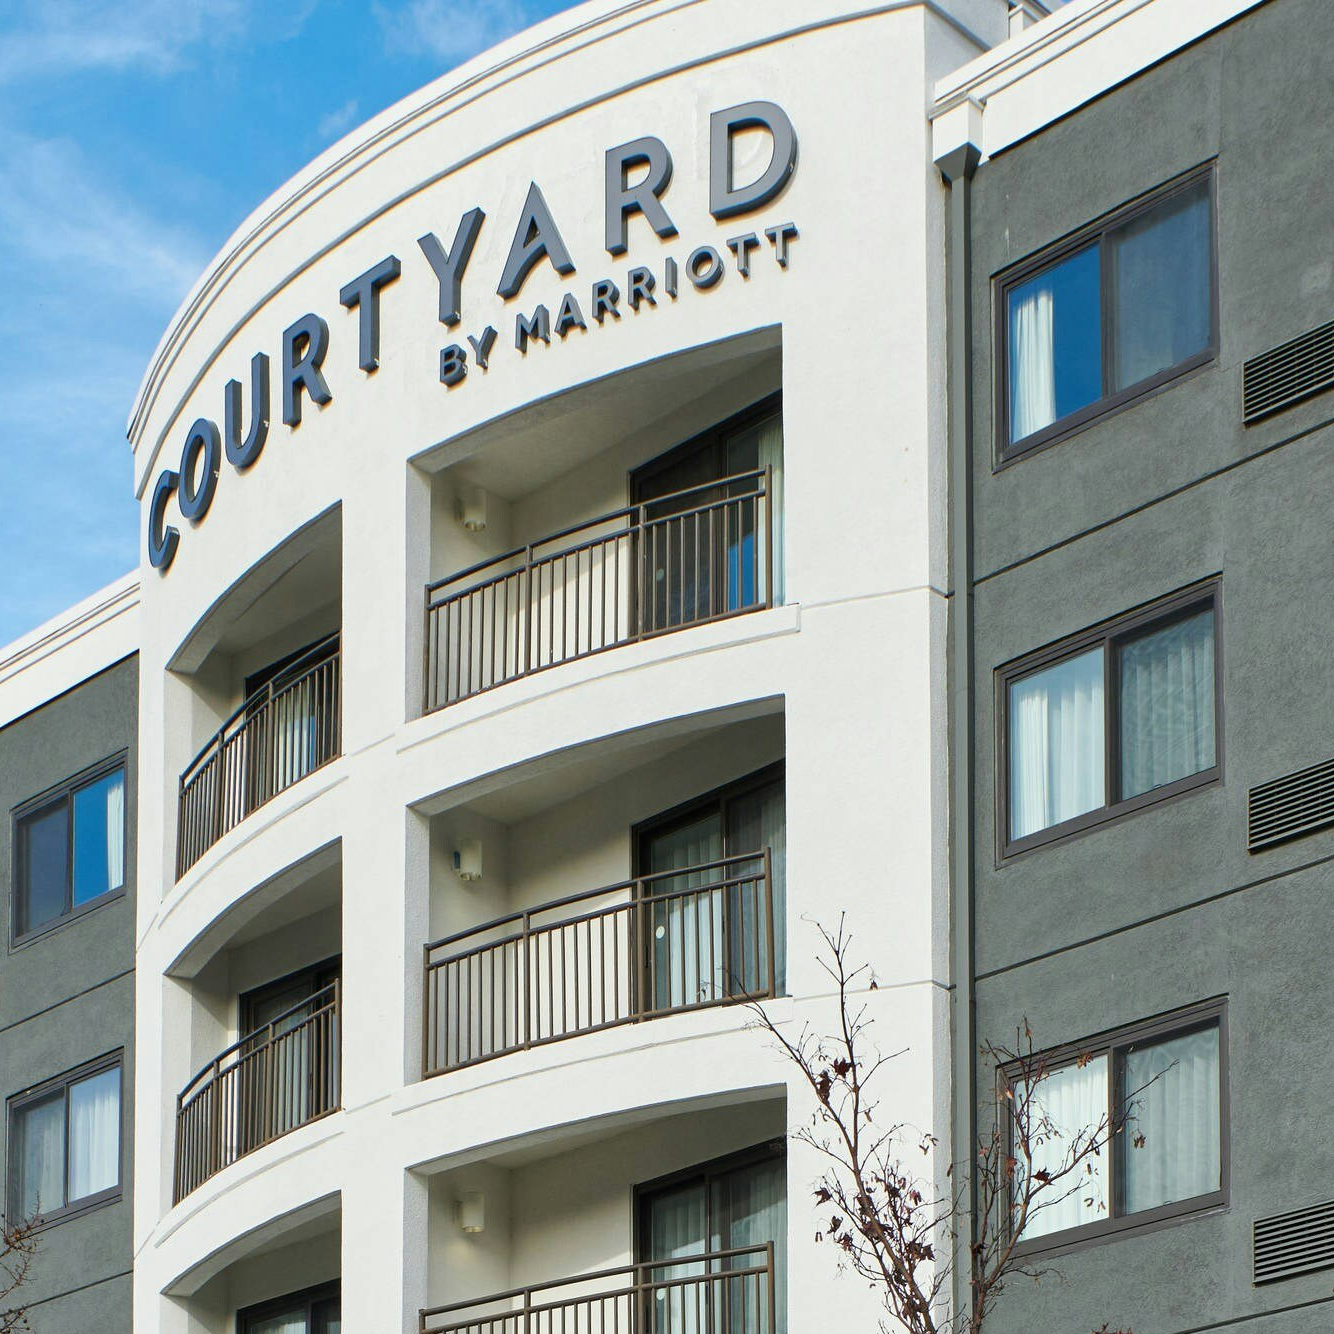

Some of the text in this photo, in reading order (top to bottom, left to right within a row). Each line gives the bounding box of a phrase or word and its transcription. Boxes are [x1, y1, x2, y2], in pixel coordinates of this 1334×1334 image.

[148, 100, 798, 571] COURTYARD
[439, 222, 798, 387] BY MARRIOTT
